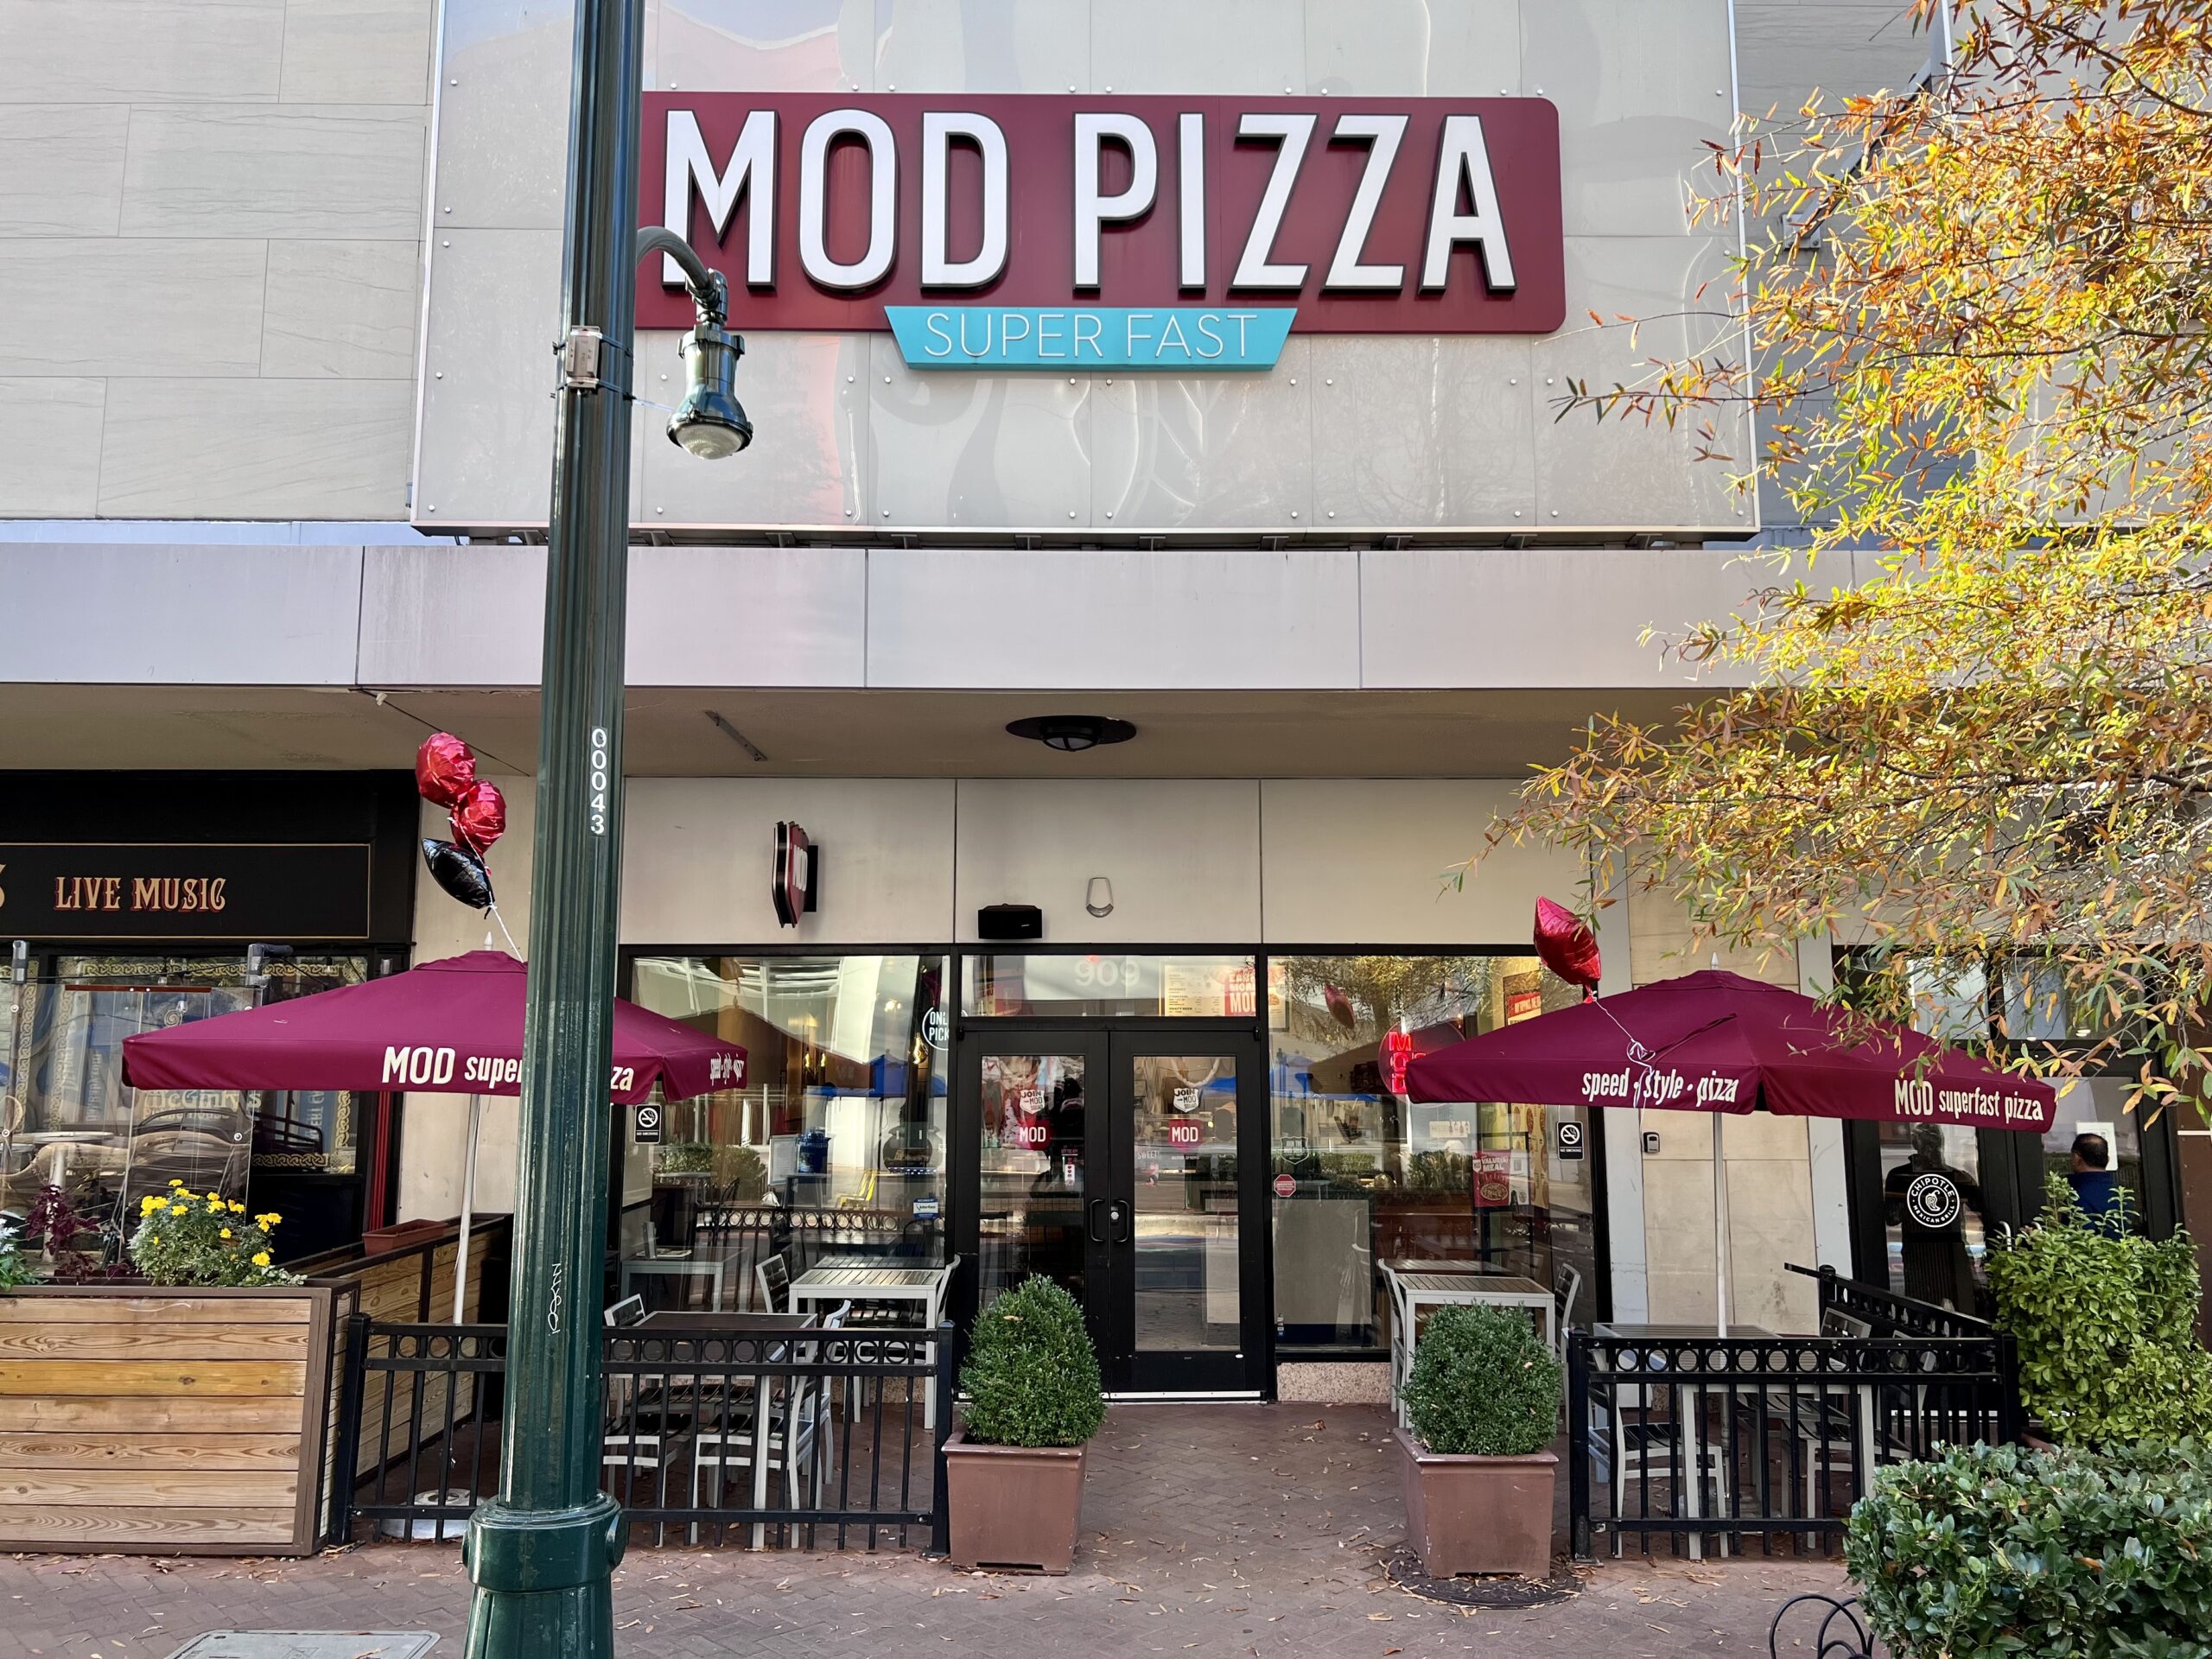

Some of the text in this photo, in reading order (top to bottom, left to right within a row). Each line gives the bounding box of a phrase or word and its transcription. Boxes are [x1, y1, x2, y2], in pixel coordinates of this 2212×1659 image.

[661, 109, 1517, 294] MOD PIZZA
[924, 313, 1258, 358] SUPER FAST
[591, 728, 607, 835] 00043
[54, 876, 226, 912] LIVE MUSIC
[1074, 959, 1141, 987] 909
[382, 1046, 455, 1085] MOD
[1581, 1067, 1739, 1107] speed style pizza
[1894, 1078, 2044, 1124] MOD superfast pizza
[1020, 1126, 1046, 1142] MOD
[1171, 1126, 1198, 1142] MOD
[1911, 1178, 1955, 1198] CHIPOTLE
[1913, 1205, 1955, 1224] MEXICAN GRILL
